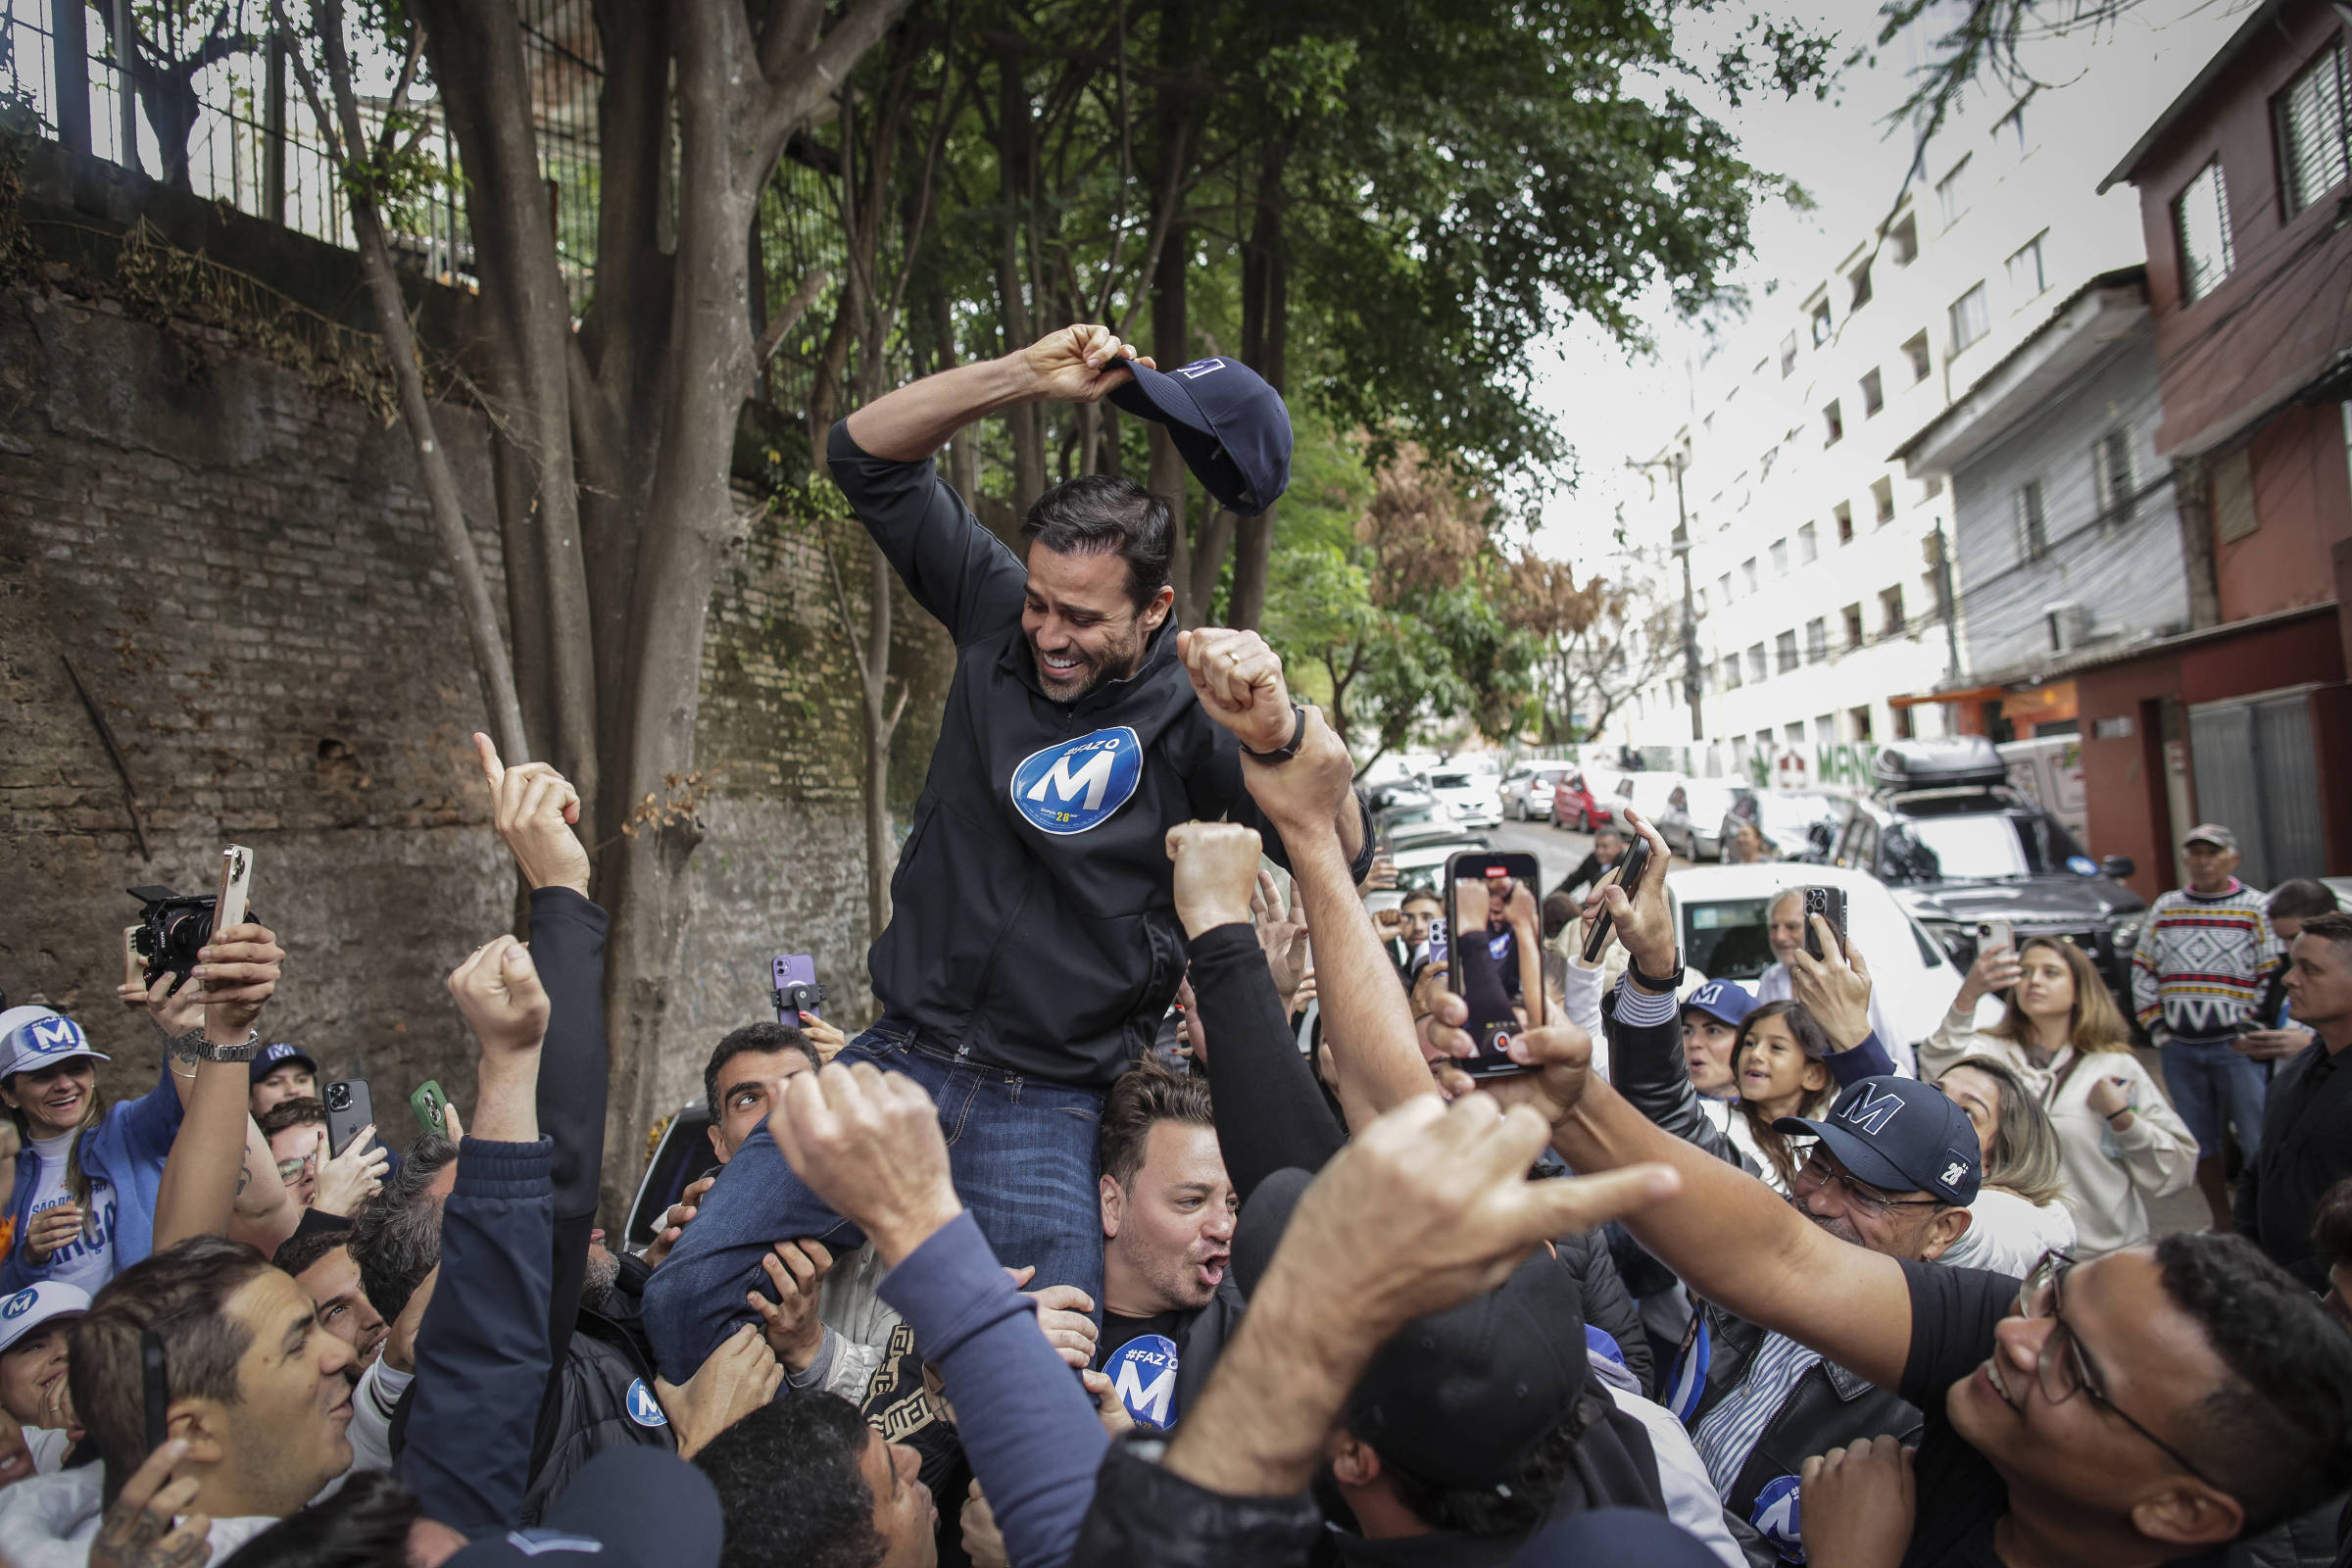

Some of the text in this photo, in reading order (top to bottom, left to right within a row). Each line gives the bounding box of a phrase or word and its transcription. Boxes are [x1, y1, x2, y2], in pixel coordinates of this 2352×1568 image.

[1026, 750, 1116, 810] M
[1055, 811, 1070, 822] 28
[1690, 984, 1725, 1005] M
[31, 1020, 76, 1051] M
[267, 1043, 296, 1060] M
[1837, 1082, 1906, 1136] M
[1940, 1162, 1963, 1186] 28
[7, 1295, 32, 1316] M
[1125, 1348, 1166, 1367] #FAZ
[1114, 1359, 1177, 1424] M
